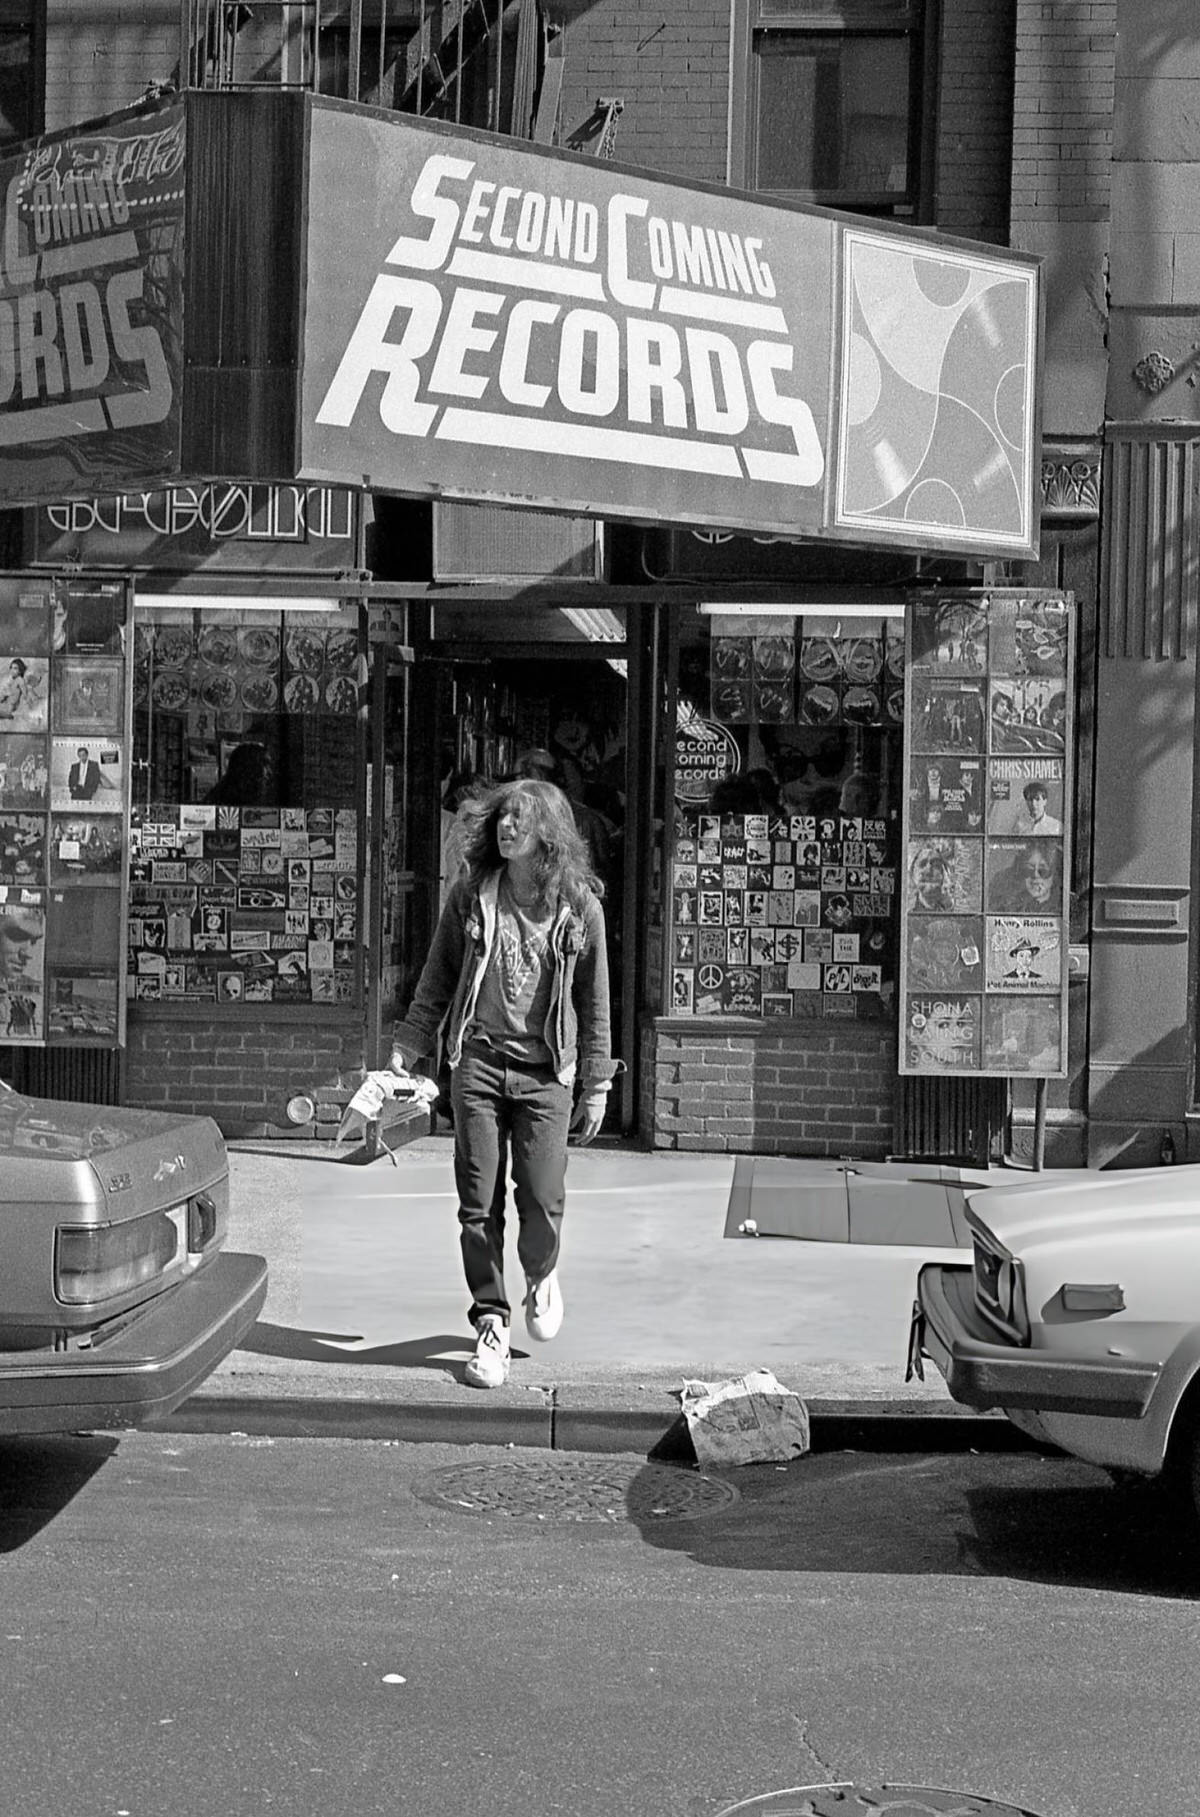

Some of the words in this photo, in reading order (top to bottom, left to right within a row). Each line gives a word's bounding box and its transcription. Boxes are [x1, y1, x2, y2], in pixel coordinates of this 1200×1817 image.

[385, 153, 599, 272] SECOND
[607, 192, 776, 311] COMING
[315, 273, 825, 487] RECORDS
[989, 759, 1021, 779] CHRIS
[1023, 919, 1054, 928] Rollins
[910, 1000, 974, 1017] SHONA
[910, 1050, 974, 1065] SOUTH
